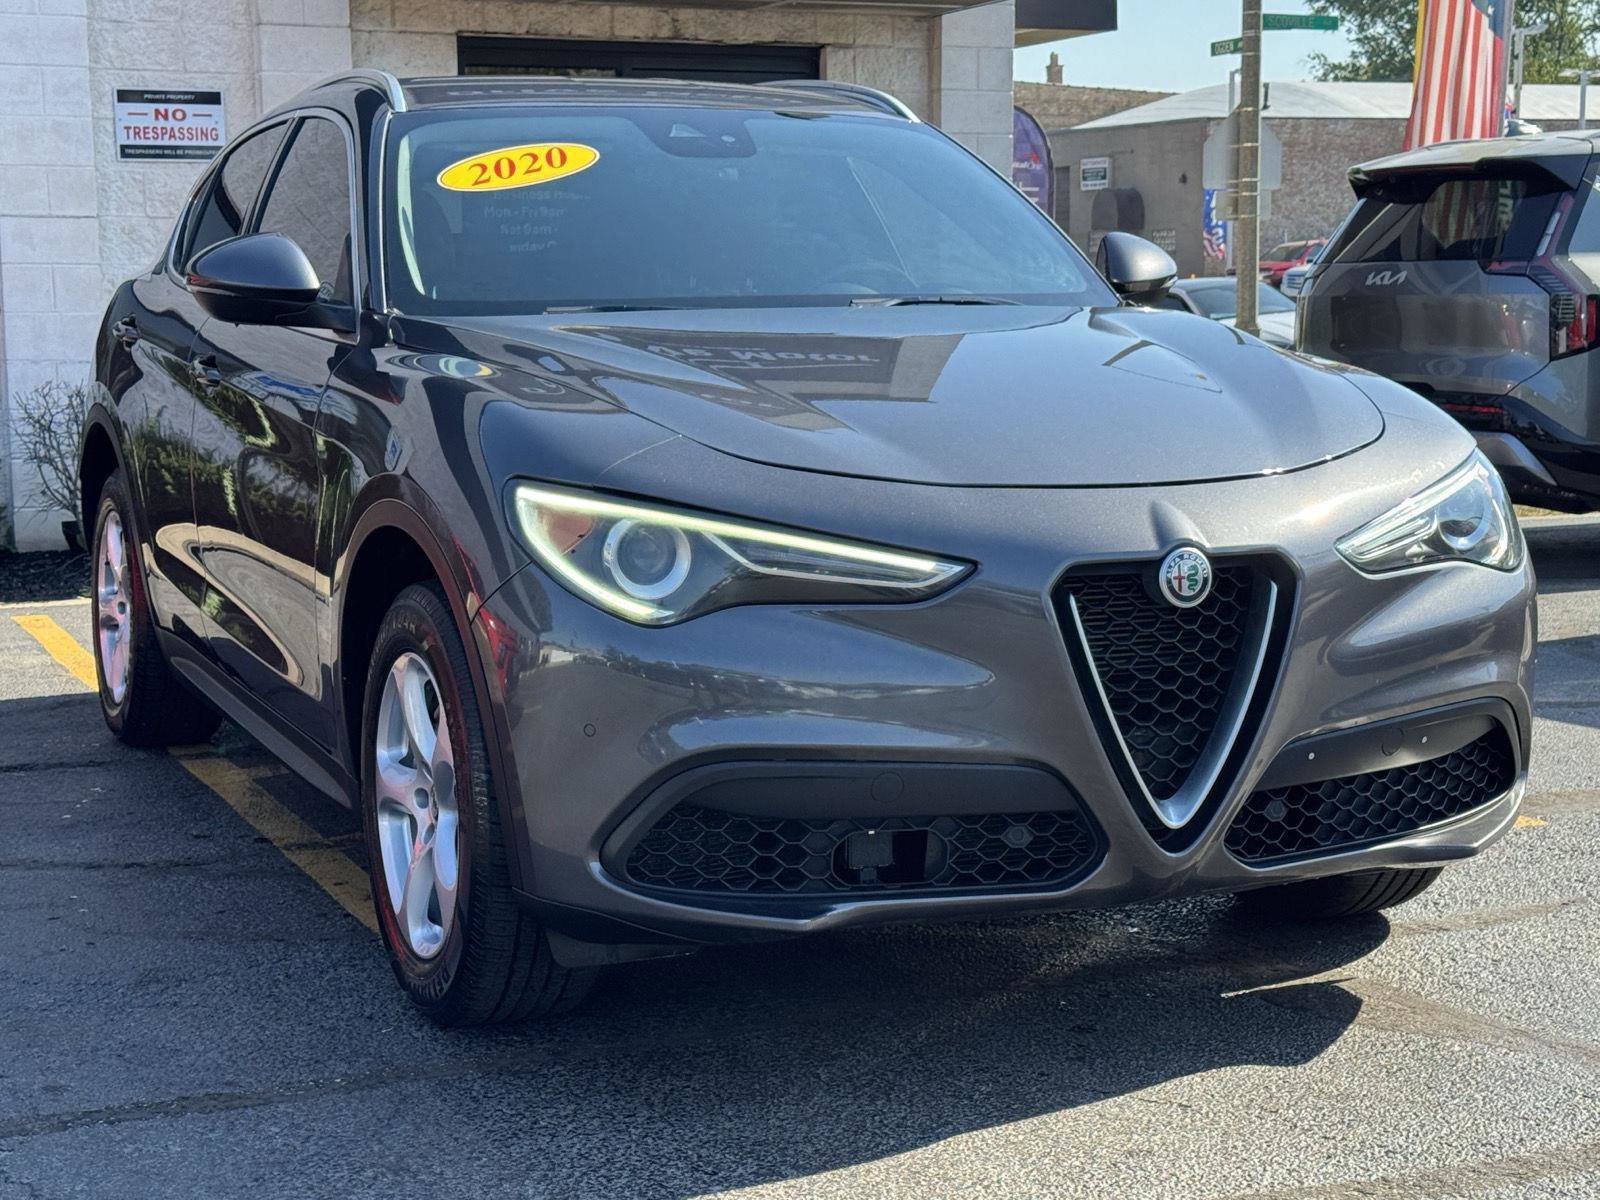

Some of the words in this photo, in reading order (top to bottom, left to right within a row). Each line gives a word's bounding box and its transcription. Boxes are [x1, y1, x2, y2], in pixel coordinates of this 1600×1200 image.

[153, 107, 187, 122] NO
[123, 125, 219, 141] TRESPASSING
[468, 146, 568, 187] 2020
[1365, 270, 1407, 286] KIA
